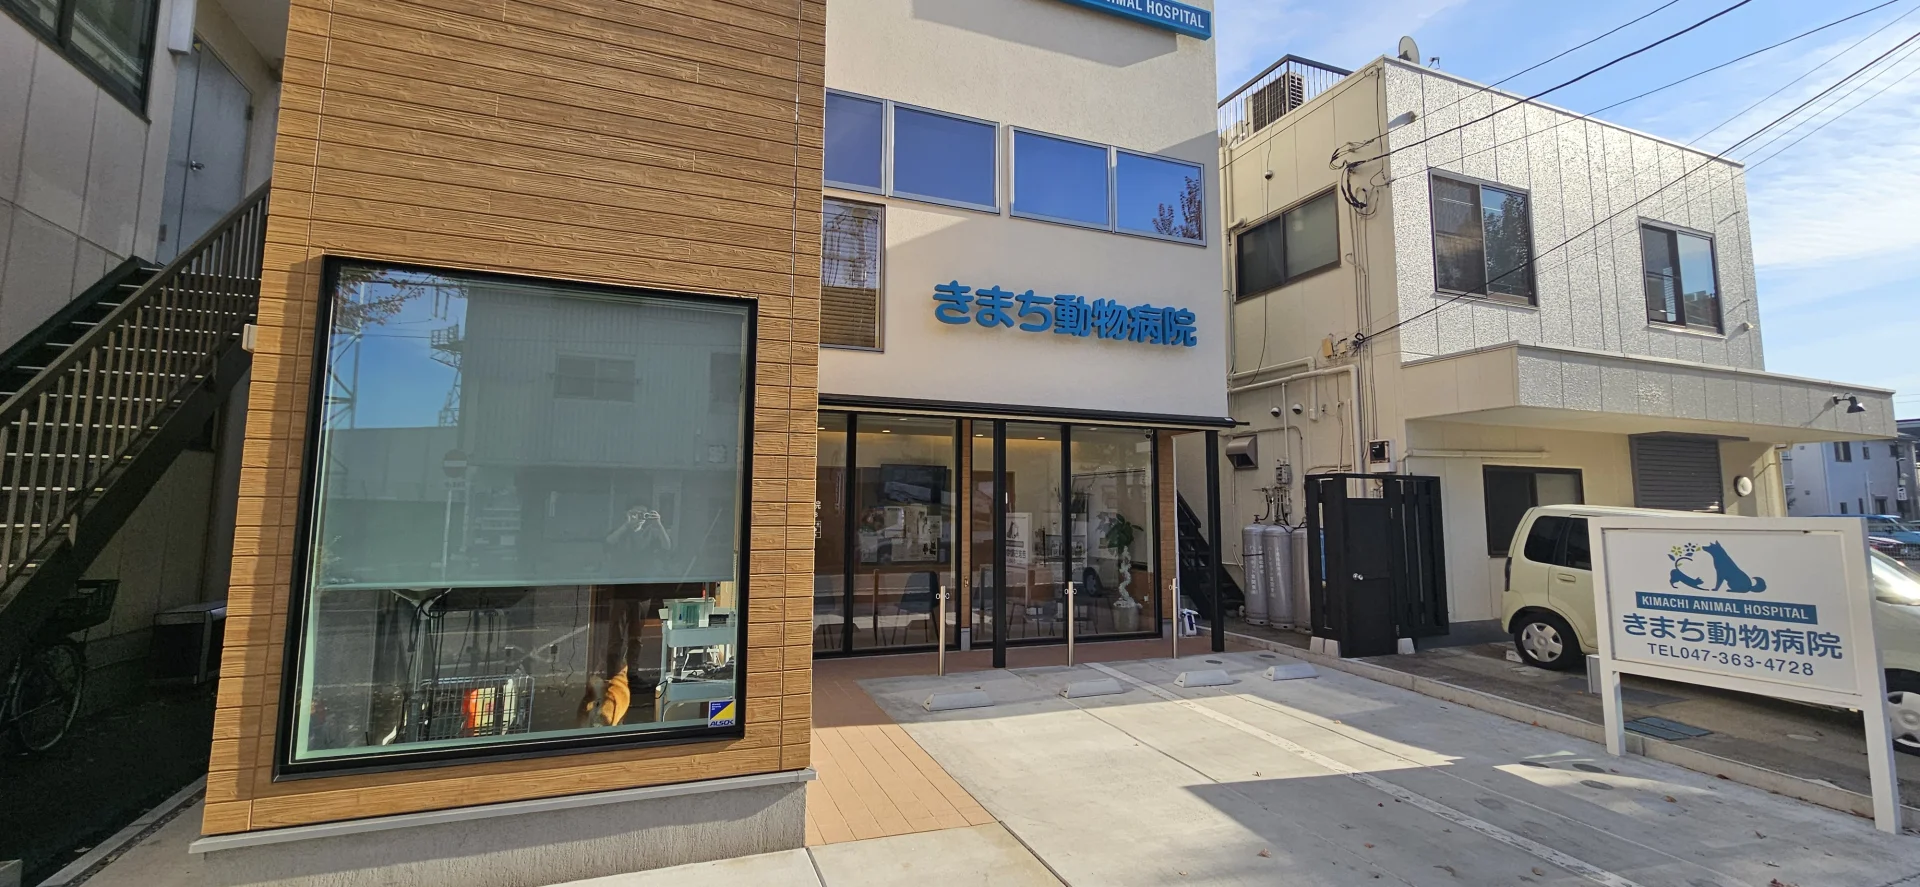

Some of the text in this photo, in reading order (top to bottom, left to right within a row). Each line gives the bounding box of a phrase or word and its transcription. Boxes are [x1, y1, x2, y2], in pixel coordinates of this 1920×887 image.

[1146, 0, 1205, 28] HOSPITAL
[933, 280, 1197, 347] きまち動物病院
[1641, 595, 1809, 620] KIMACHI ANIMAL HOSPITAL
[1623, 612, 1843, 660] きまち動物病院
[1647, 642, 1814, 676] TEL047-363-4728
